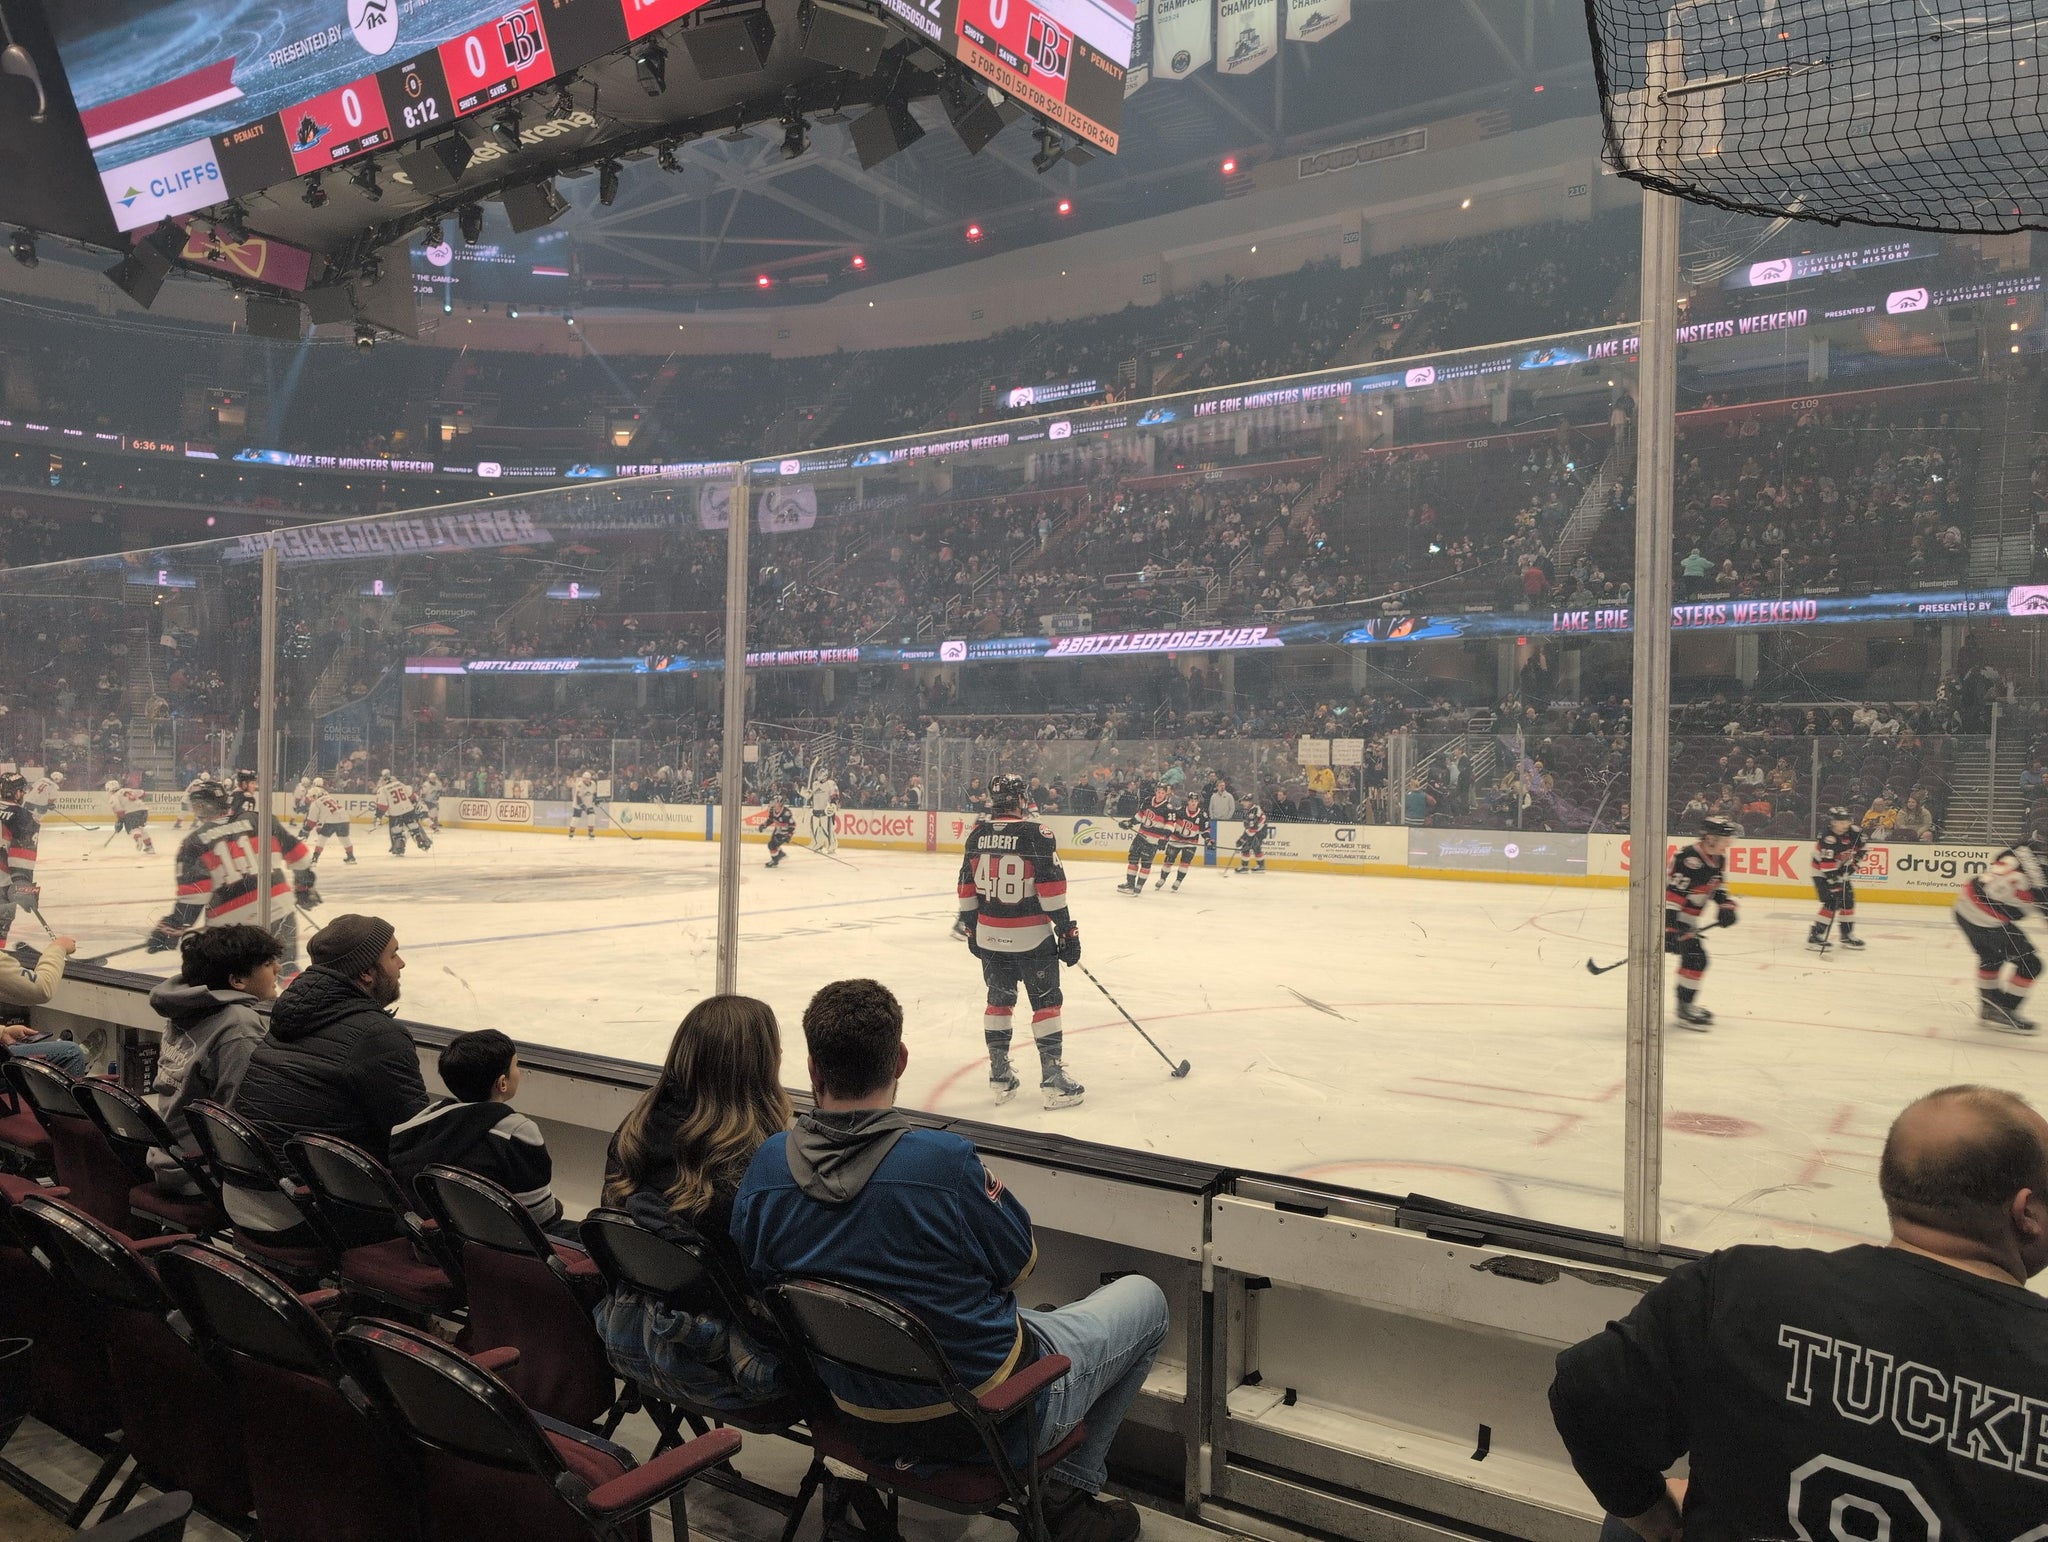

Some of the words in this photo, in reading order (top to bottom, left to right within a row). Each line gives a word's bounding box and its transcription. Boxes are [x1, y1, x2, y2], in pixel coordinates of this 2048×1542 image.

[1157, 0, 1207, 15] CHAMPI
[1221, 0, 1275, 17] CHAMPIO
[964, 23, 985, 45] SHOTS
[269, 31, 328, 69] PRESENTED
[328, 24, 344, 43] BY
[464, 37, 486, 78] 0
[999, 49, 1018, 67] SAVES
[1091, 54, 1124, 81] PENALTY
[489, 83, 508, 97] SAVES
[341, 89, 362, 128] 0
[459, 96, 478, 110] SHOTS
[971, 52, 977, 64] 5
[978, 56, 995, 74] FOR
[996, 68, 1012, 87] $10
[1016, 80, 1028, 97] 50
[1029, 88, 1045, 105] FOR
[1047, 98, 1062, 118] $20
[1068, 111, 1082, 129] 125
[1082, 119, 1098, 138] FOR
[1099, 130, 1115, 148] $40
[403, 98, 439, 128] 8:12
[233, 125, 264, 144] PENALTY
[362, 134, 379, 147] SAVES
[331, 146, 350, 158] SHOTS
[150, 162, 218, 197] CLIFFS
[1797, 251, 1858, 267] CLEVELAND
[1864, 242, 1910, 257] MUSEUM
[1811, 260, 1857, 273] NATURAL
[1862, 251, 1910, 265] HISTORY
[1933, 282, 1992, 297] CLEVELAND
[1997, 276, 2042, 288] MUSEUM
[1946, 290, 1992, 303] NATURAL
[1996, 283, 2041, 297] HISTORY
[1588, 341, 1618, 359] LAKE
[1622, 338, 1641, 353] ER
[1676, 320, 1734, 344] NSTERS
[1739, 309, 1808, 334] WEEKEND
[1824, 307, 1864, 318] PRESENTED
[1866, 306, 1876, 314] BY
[1446, 369, 1479, 380] NATURAL
[1481, 364, 1511, 374] HISTORY
[1194, 402, 1217, 417] LAKE
[1220, 400, 1241, 414] ERIE
[1244, 390, 1299, 411] MONSTERS
[1302, 382, 1352, 400] WEEKEND
[1362, 382, 1388, 390] PRESENTED
[132, 440, 156, 450] 6:36
[160, 443, 174, 452] PM
[890, 449, 908, 461] LAKE
[909, 446, 926, 458] ERIE
[928, 440, 970, 456] MONSTERS
[971, 434, 1010, 450] WEEKEND
[288, 454, 313, 468] LAKE
[316, 457, 337, 468] ERIE
[339, 457, 389, 471] MONSTERS
[391, 460, 434, 474] WEEKEND
[616, 465, 636, 477] LAKE
[639, 464, 657, 477] ERIE
[158, 570, 167, 585] E
[1919, 580, 1959, 588] Huntington
[374, 579, 383, 595] R
[569, 582, 579, 598] S
[1804, 586, 1840, 595] Huntington
[424, 607, 477, 616] Construction
[1553, 611, 1589, 631] LAKE
[1595, 609, 1629, 630] ERIE
[1671, 604, 1727, 626] STERS
[1733, 600, 1817, 624] WEEKEND
[1919, 602, 1976, 612] PRESENTED
[1978, 601, 1992, 611] BY
[1057, 627, 1267, 653] #BATTLEDTOGETHER
[746, 653, 758, 666] AKE
[760, 652, 776, 666] ERIE
[778, 650, 818, 665] MONSTERS
[820, 648, 859, 663] WEEKEND
[390, 788, 407, 804] 36
[344, 800, 377, 811] IFFS
[633, 811, 662, 822] MEDICAL
[665, 812, 693, 823] MUTUAL
[843, 813, 914, 837] Rocket
[978, 835, 1018, 850] GILBERT
[1934, 850, 1989, 859] DISCOUNT
[1897, 854, 1956, 878] drug
[974, 853, 1025, 904] 48
[1917, 880, 1948, 888] Employee
